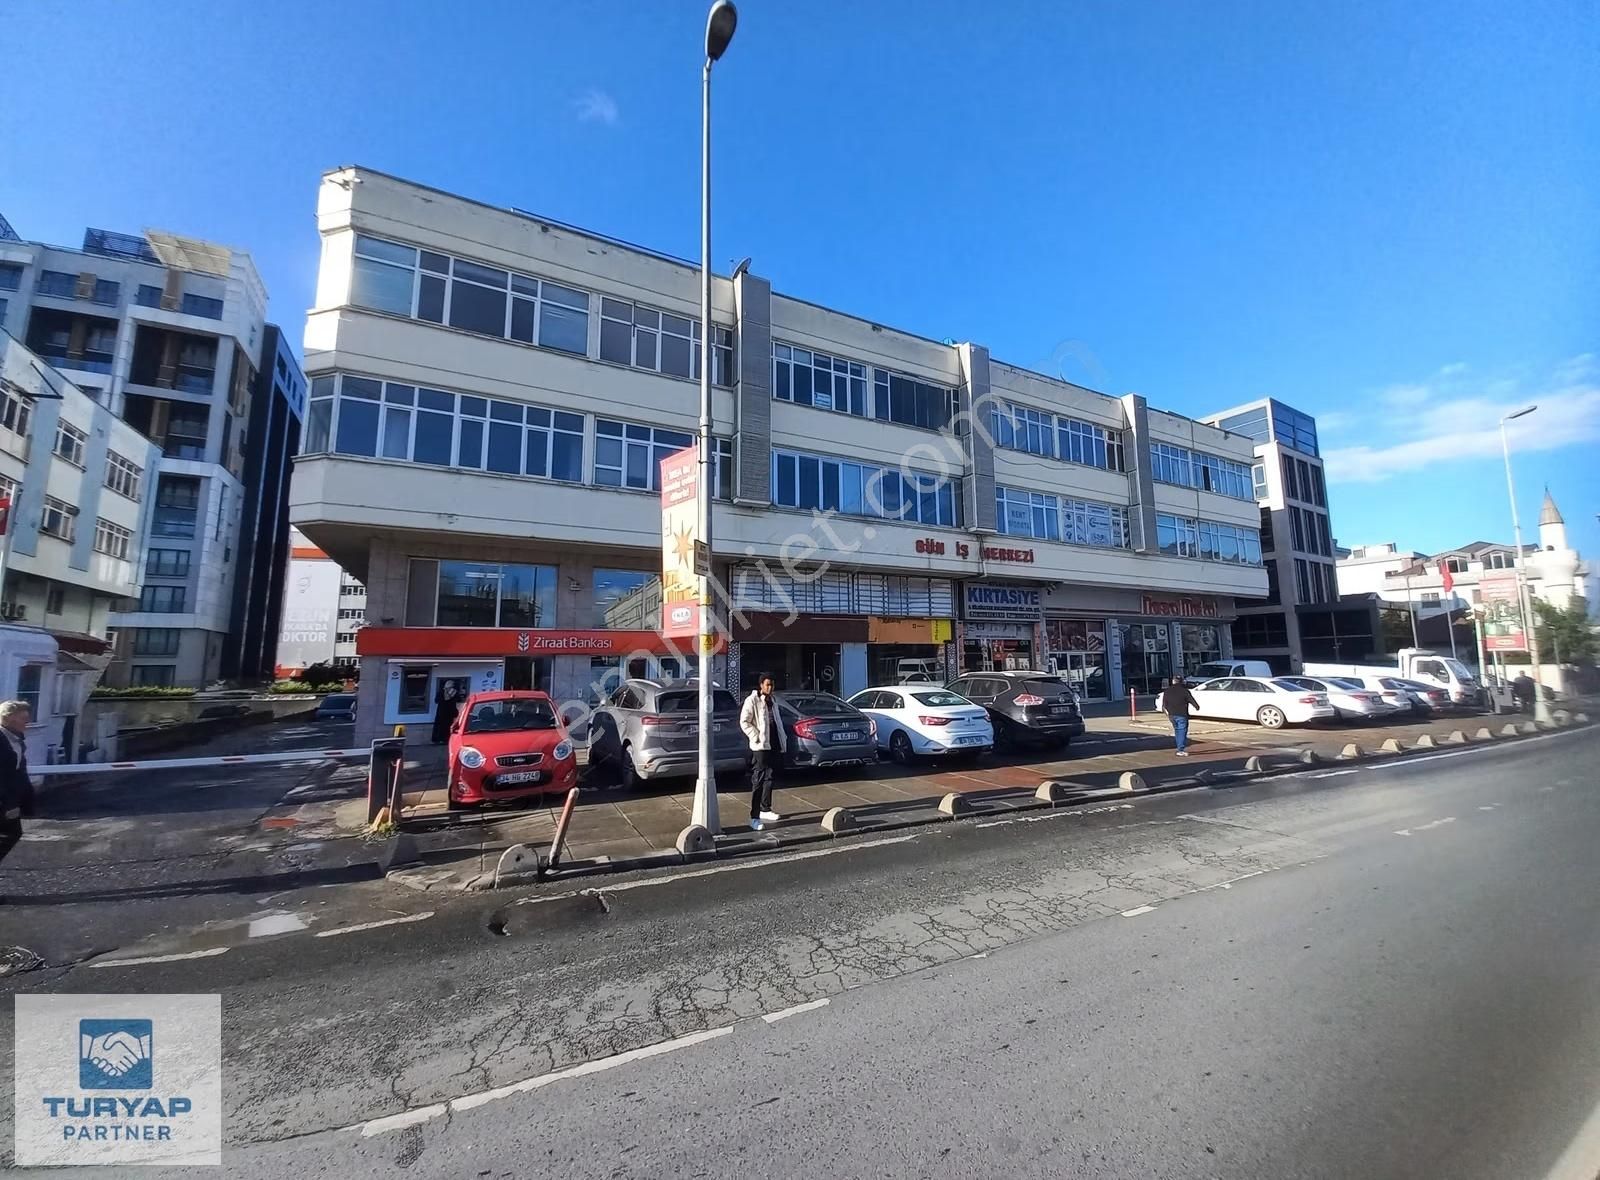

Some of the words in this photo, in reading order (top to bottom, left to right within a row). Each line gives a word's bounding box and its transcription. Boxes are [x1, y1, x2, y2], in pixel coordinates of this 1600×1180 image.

[915, 538, 945, 555] GÜN
[956, 541, 969, 560] İŞ
[967, 586, 1040, 605] KIRTASİYE
[533, 636, 567, 648] Ziraat
[569, 637, 612, 649] Bankası
